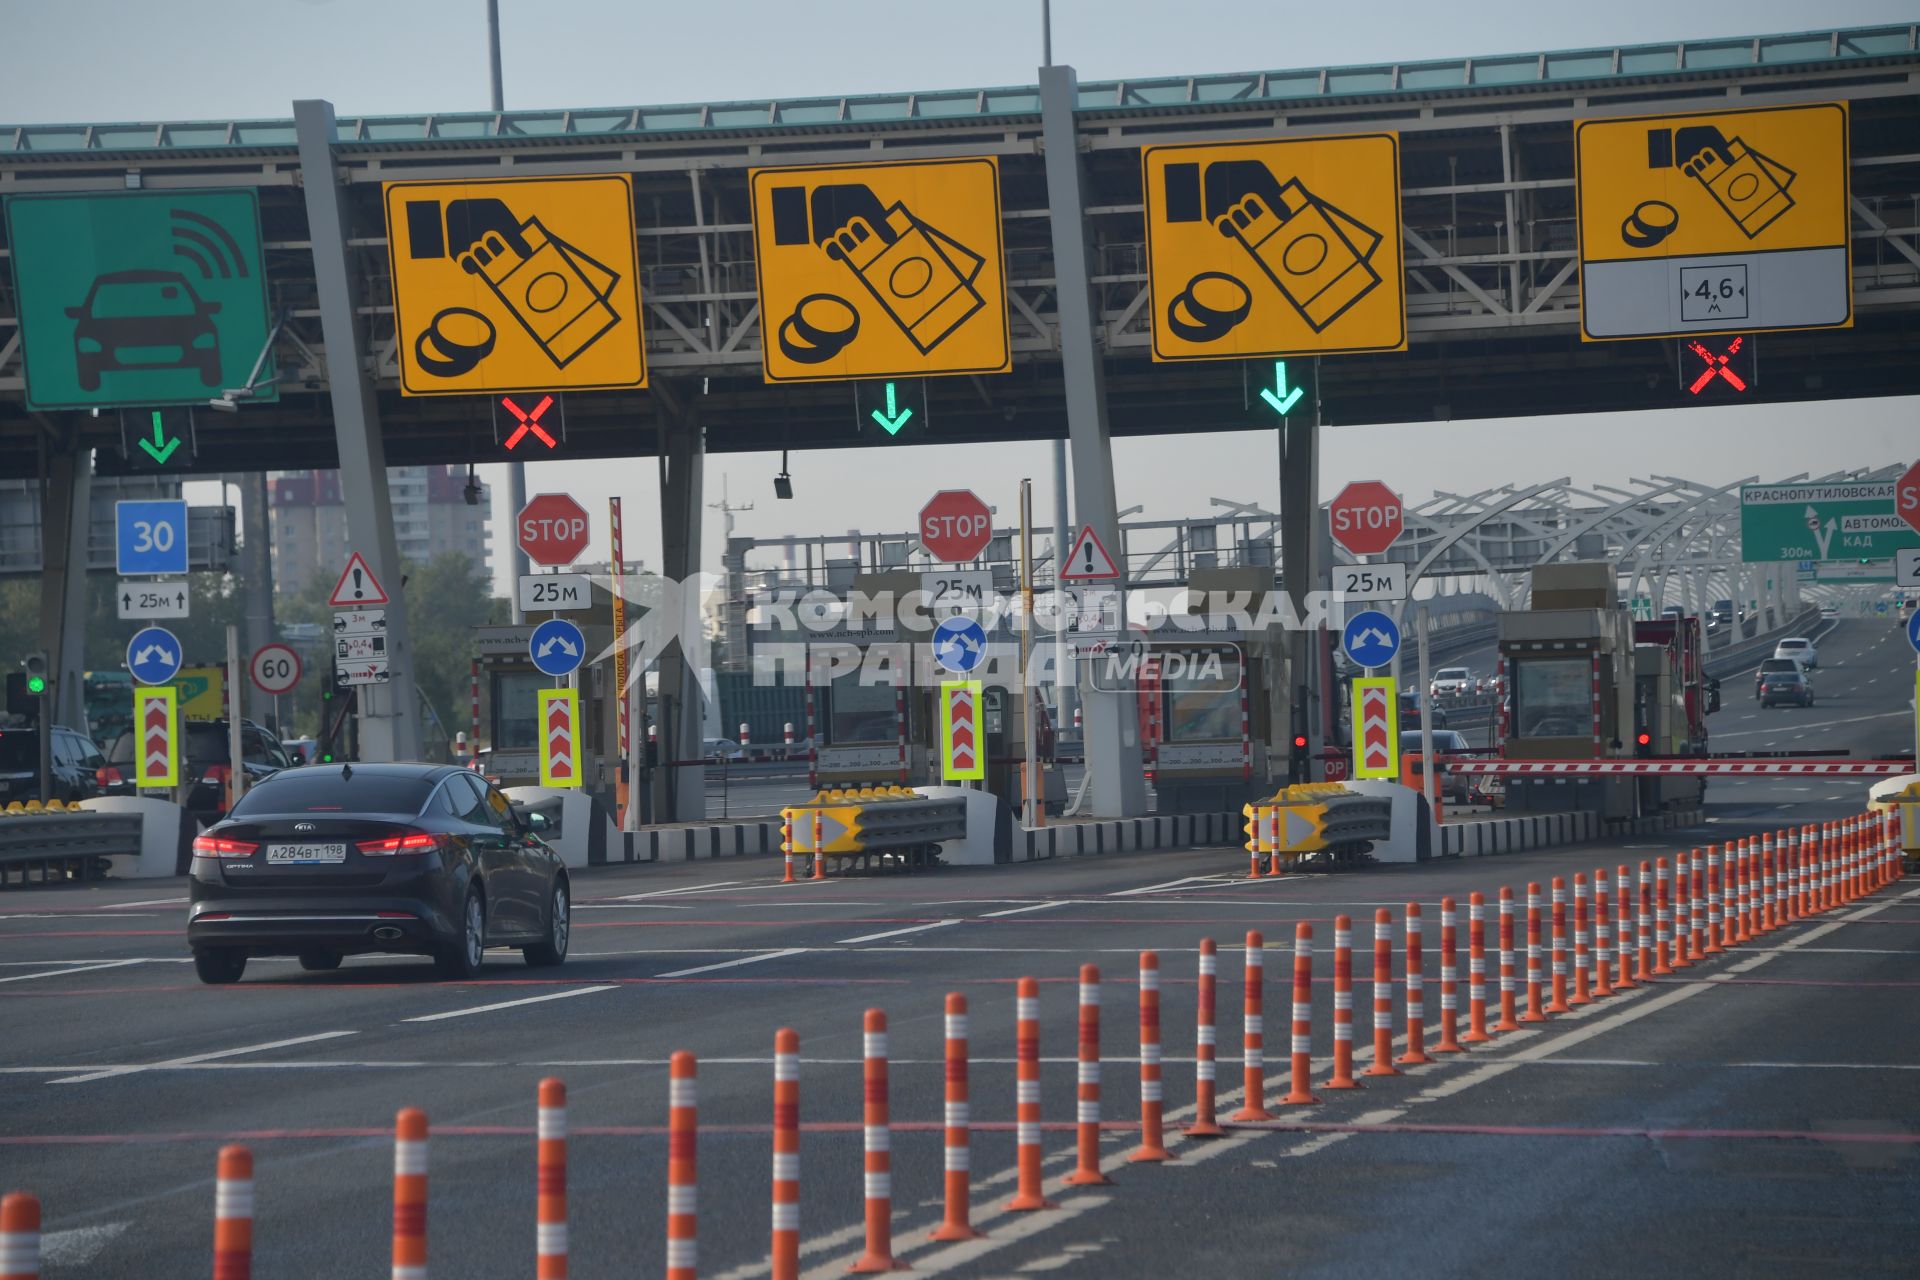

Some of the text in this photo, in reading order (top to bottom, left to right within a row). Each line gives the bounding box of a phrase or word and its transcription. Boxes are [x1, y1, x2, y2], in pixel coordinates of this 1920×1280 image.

[1694, 277, 1734, 302] 4,6
[1744, 485, 1895, 502] КРАСНОПУТИЛОВСКАЯ
[925, 514, 988, 539] STOP
[1335, 505, 1399, 531] STOP
[133, 520, 174, 552] 30
[523, 518, 585, 542] STOP
[1843, 535, 1873, 547] КАД
[1780, 547, 1813, 559] 300м
[532, 582, 578, 602] 25м
[1346, 572, 1392, 593] 25м
[139, 593, 170, 608] 25м
[476, 635, 529, 645] www.nch-s
[809, 628, 895, 640] www.nch-spb.com
[262, 659, 289, 679] 60
[617, 652, 625, 691] ПОЛОСА
[297, 823, 313, 831] KIA
[323, 845, 343, 855] 198
